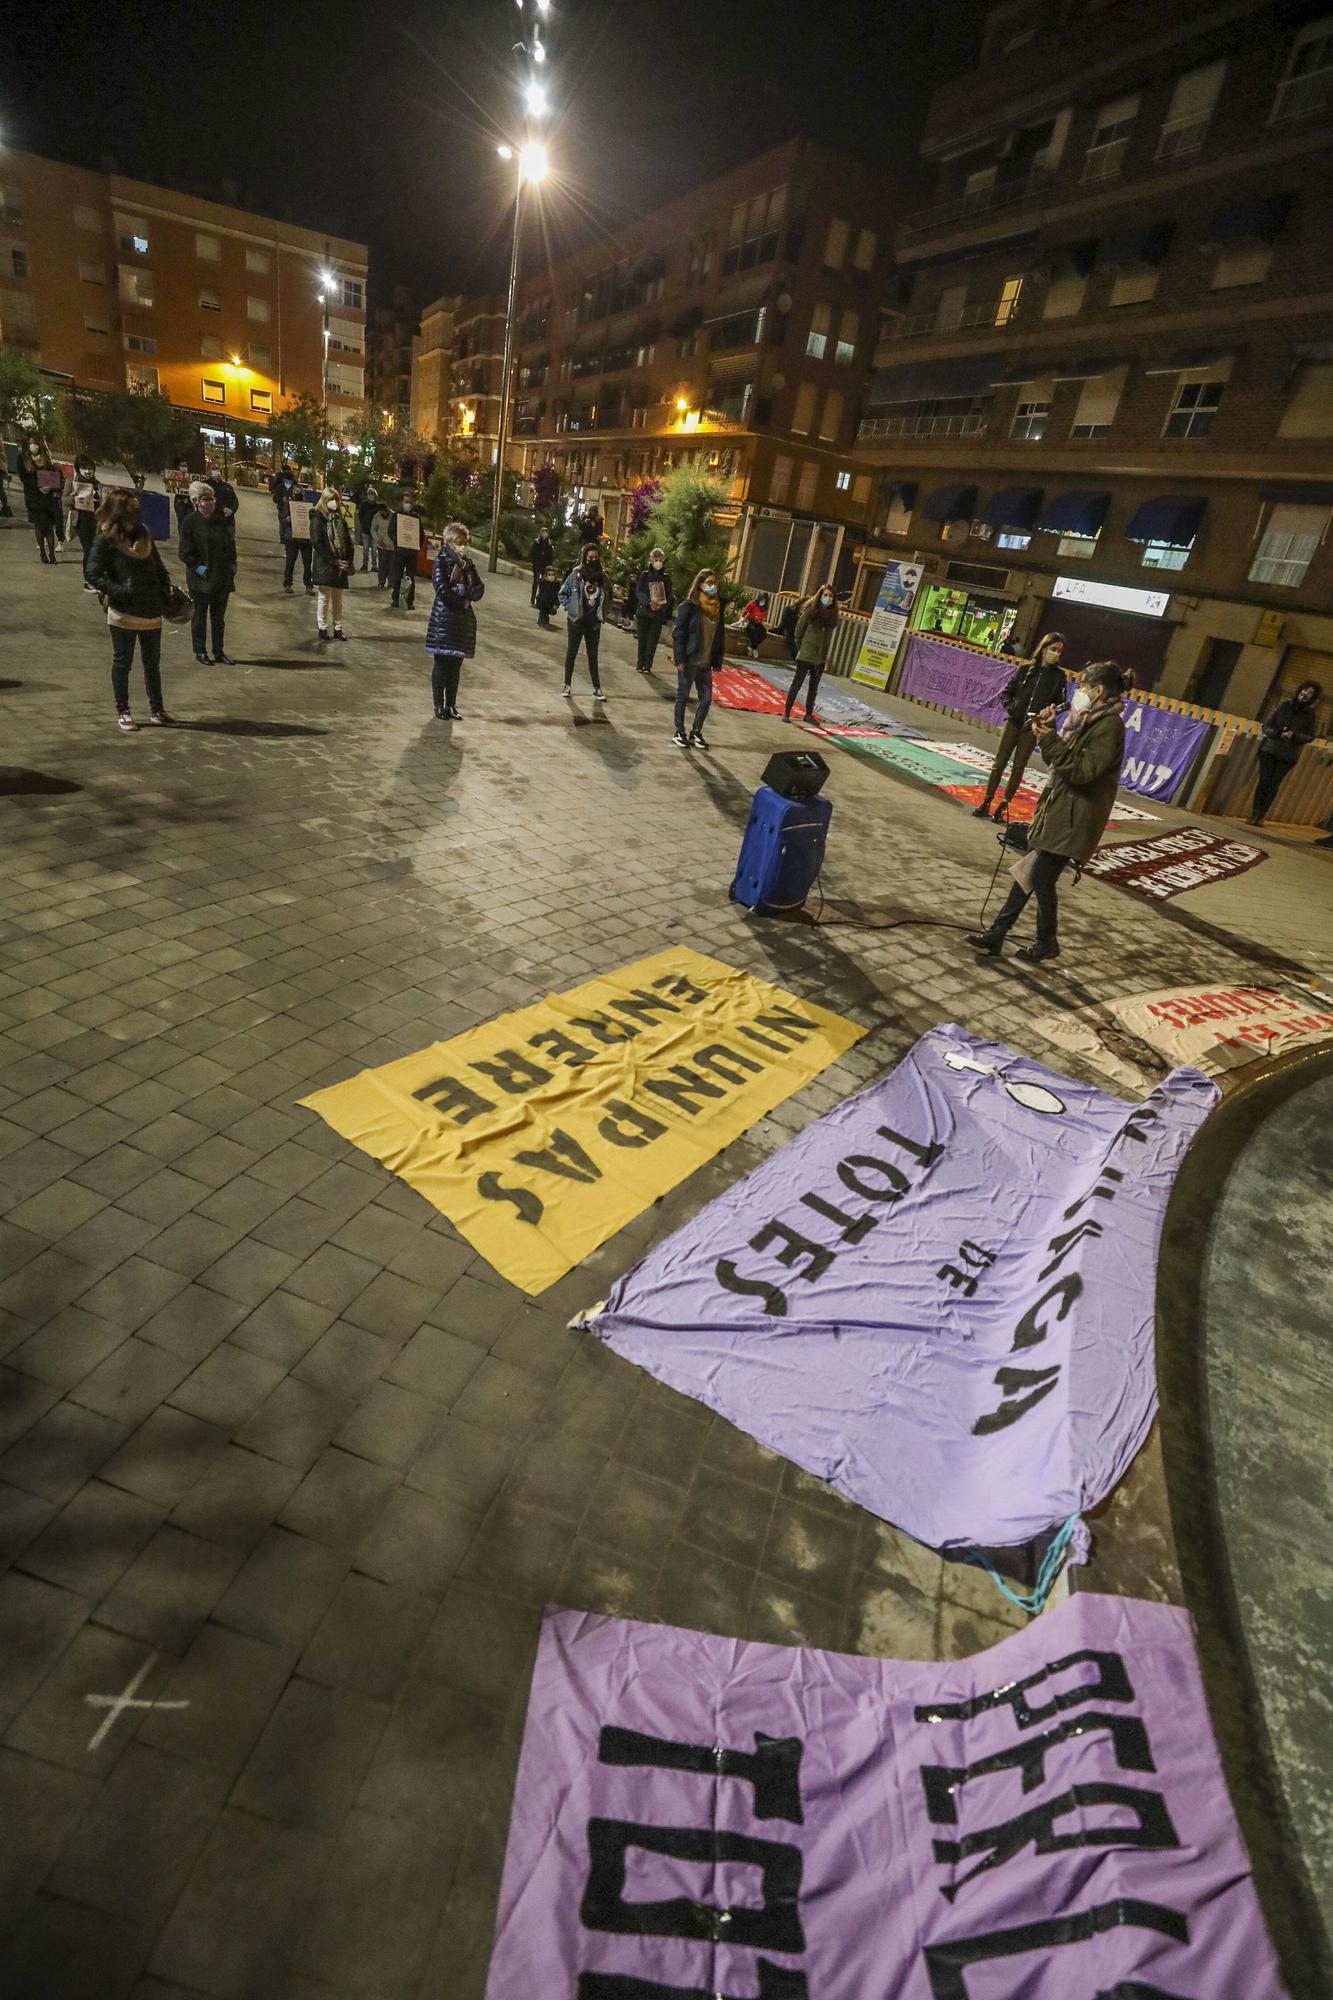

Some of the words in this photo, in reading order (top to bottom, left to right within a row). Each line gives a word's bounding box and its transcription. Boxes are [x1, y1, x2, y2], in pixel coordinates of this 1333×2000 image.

[411, 973, 711, 1126] ENRERE
[642, 1043, 765, 1117] UN
[736, 1004, 820, 1056] NI
[476, 1102, 670, 1228] PAS
[714, 1125, 946, 1318] TOTES
[936, 1238, 998, 1299] DE
[914, 1649, 1180, 1904] PER
[575, 1723, 808, 2000] TO
